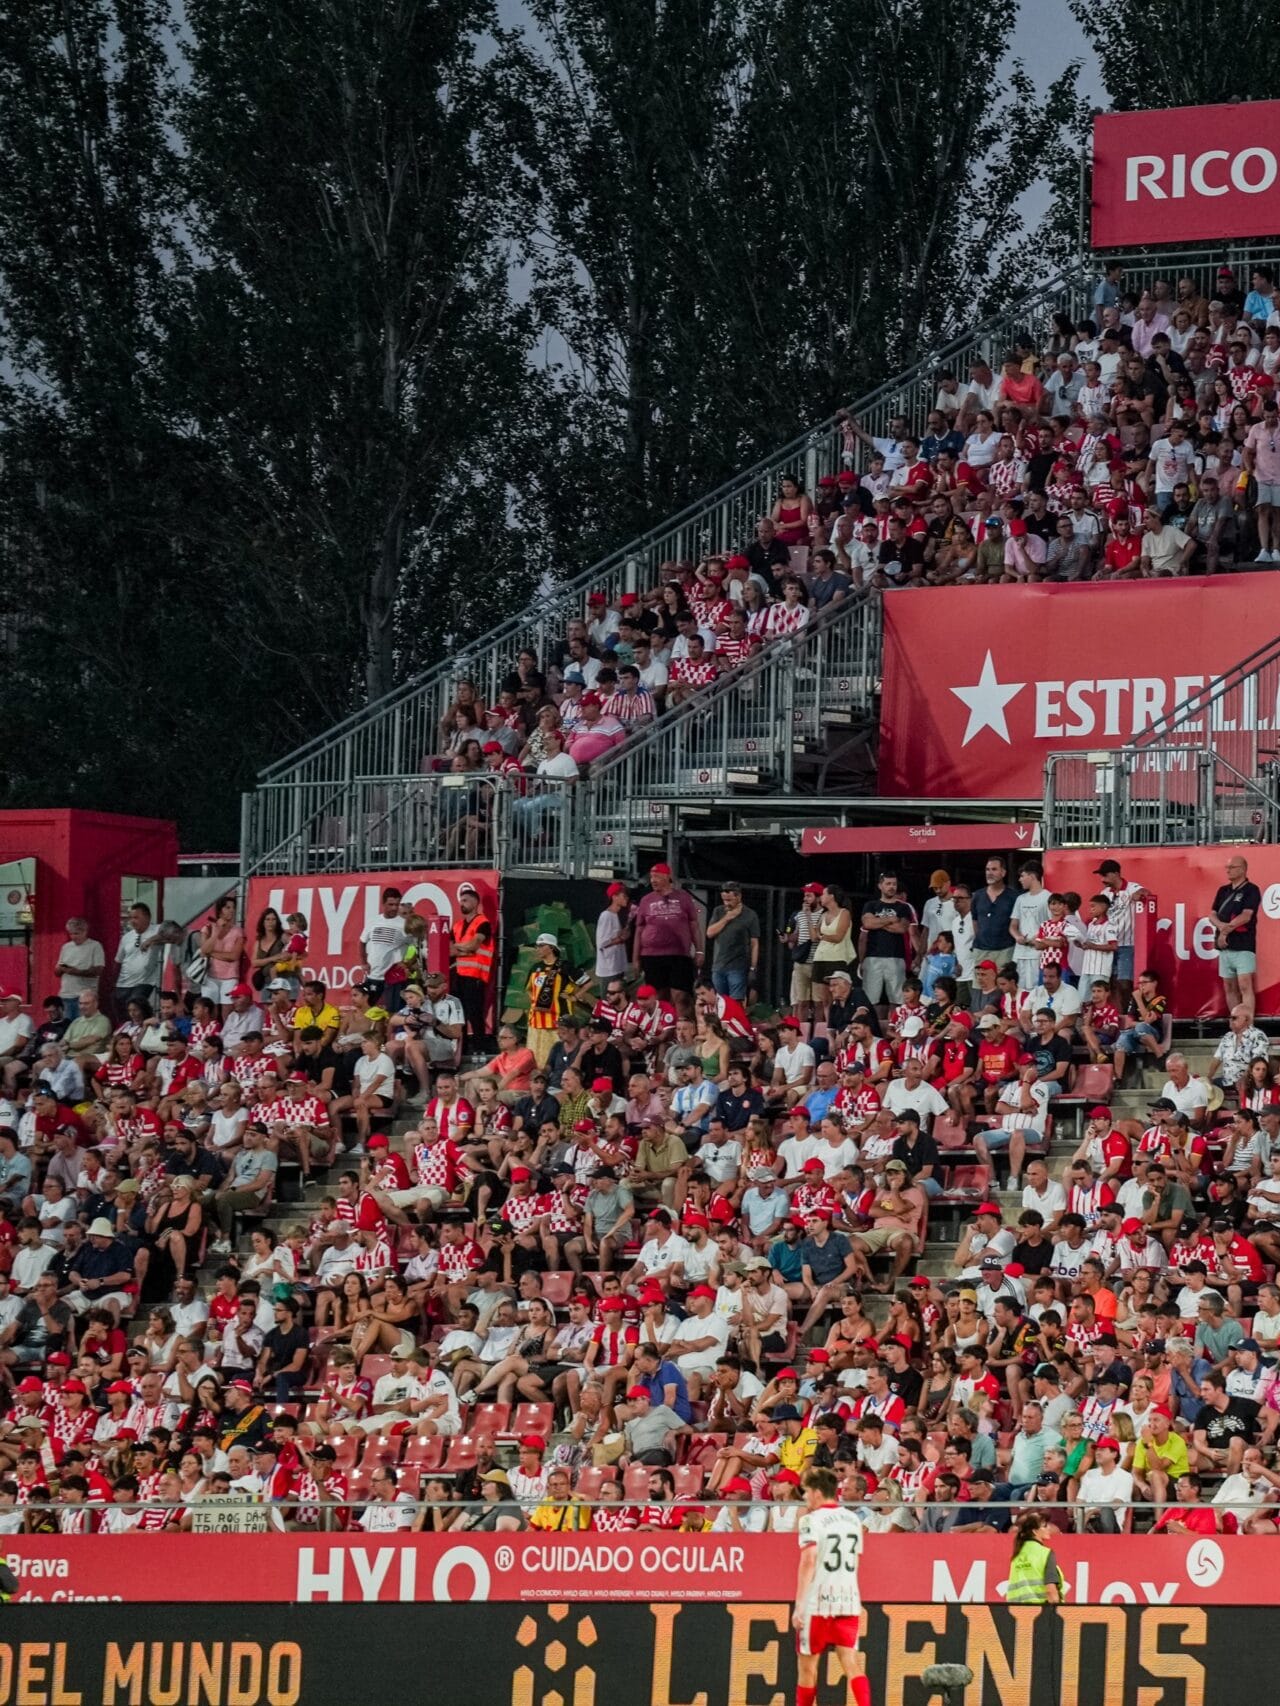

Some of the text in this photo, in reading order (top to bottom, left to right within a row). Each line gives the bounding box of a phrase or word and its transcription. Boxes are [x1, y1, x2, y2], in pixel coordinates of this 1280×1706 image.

[909, 827, 936, 837] Sortida
[194, 1512, 212, 1523] TE
[218, 1511, 241, 1524] ROG
[5, 1554, 70, 1578] Brava
[521, 1546, 635, 1574] CUIDADO
[640, 1546, 745, 1574] OCULAR
[823, 1533, 859, 1573] 33
[103, 1641, 302, 1706] MUNDO
